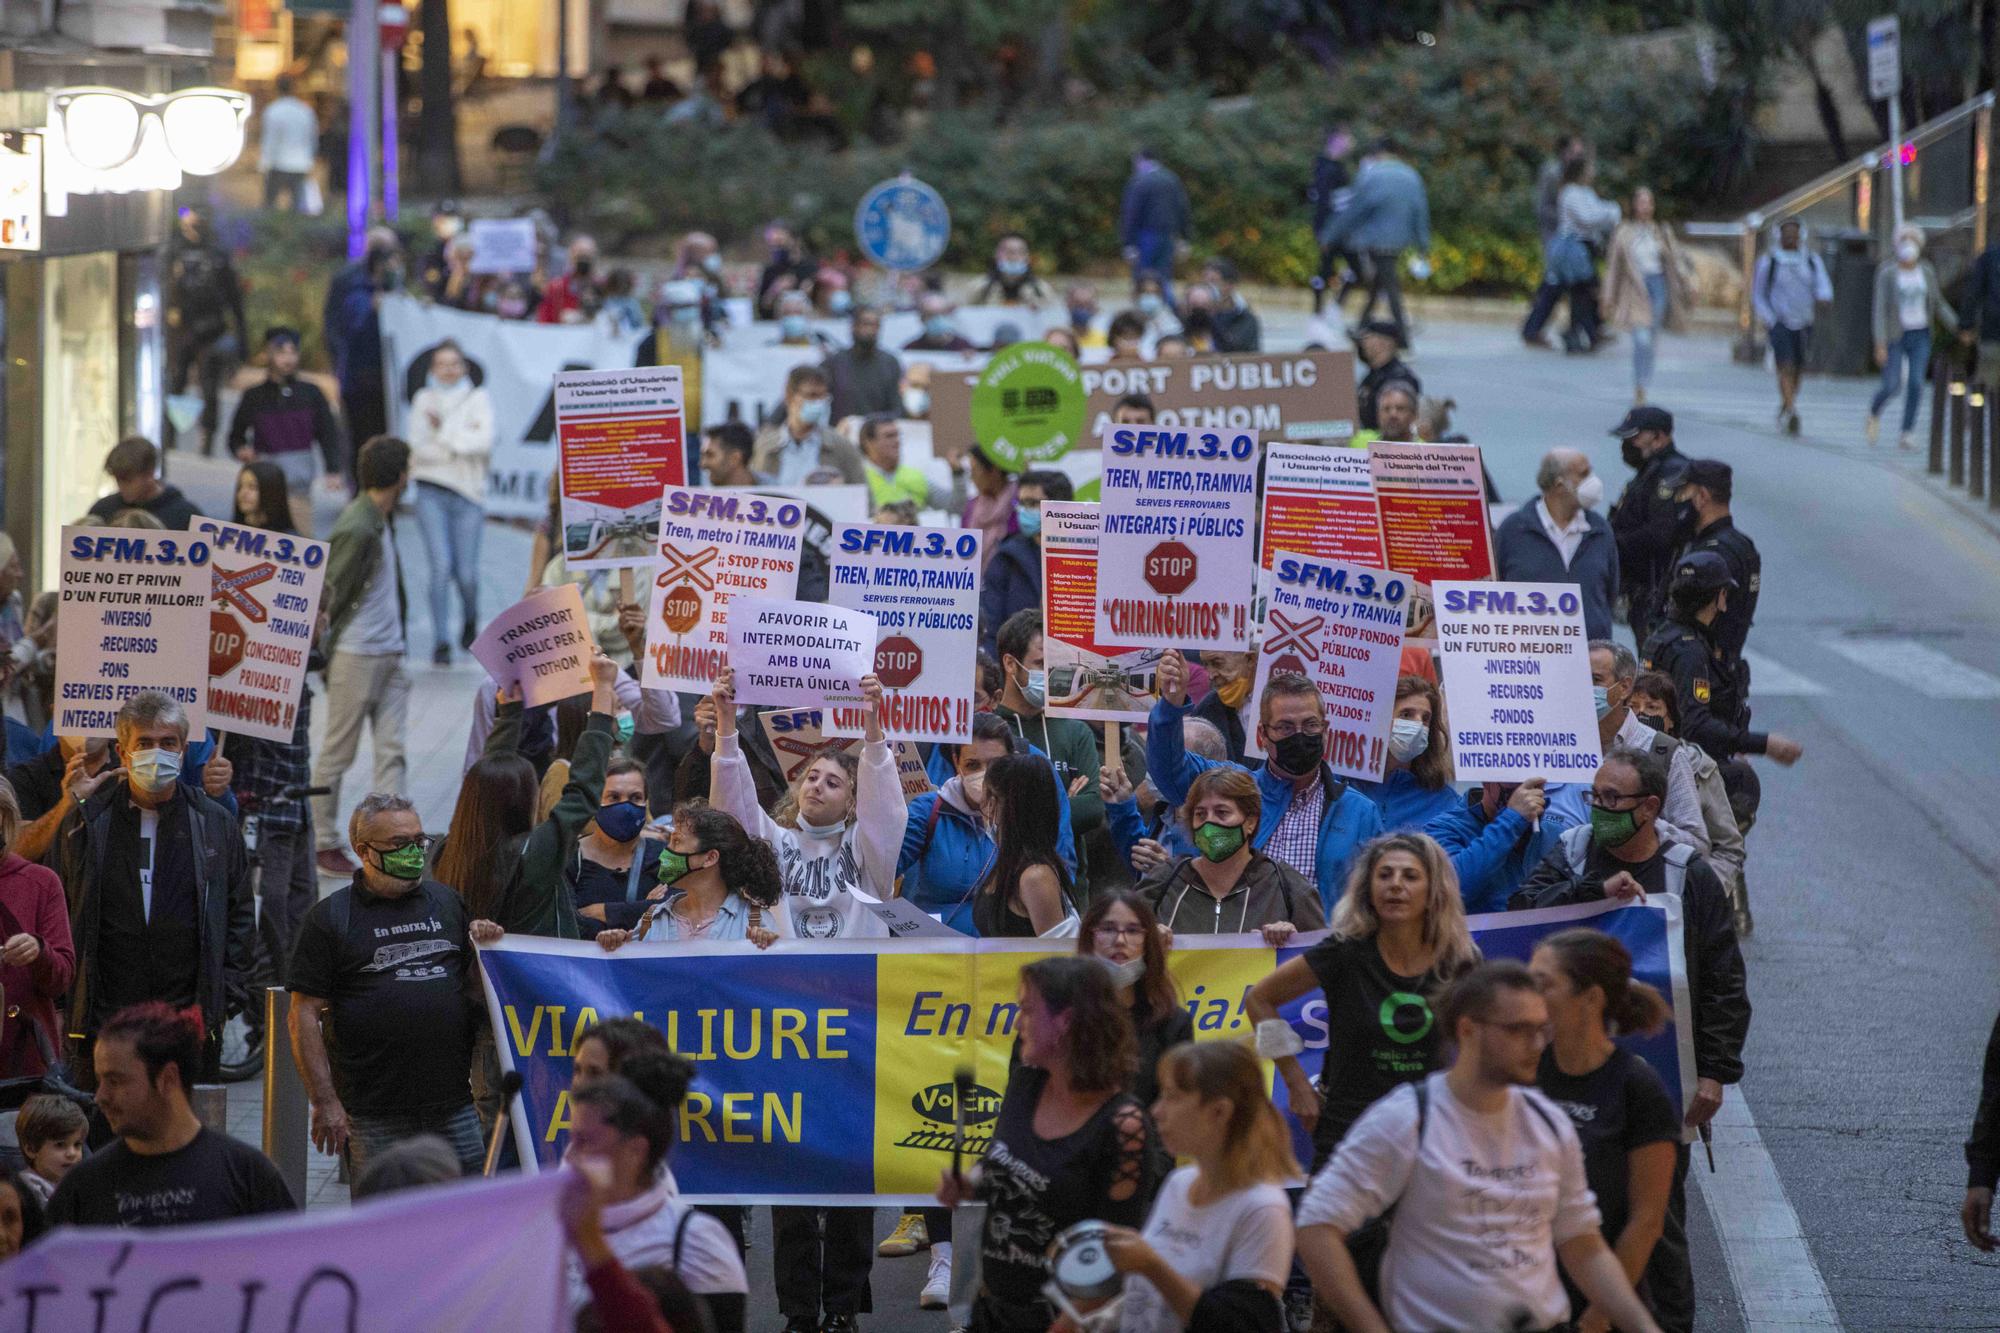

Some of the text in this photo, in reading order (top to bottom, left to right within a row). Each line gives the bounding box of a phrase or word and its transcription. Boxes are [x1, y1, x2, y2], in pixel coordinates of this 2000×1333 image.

[1190, 358, 1318, 391] PÚBLIC
[1155, 404, 1282, 432] OTHOM
[1111, 430, 1253, 460] SFM.3.0
[1107, 468, 1142, 492] TREN,
[1353, 467, 1371, 475] Tre
[667, 491, 801, 527] SFM.3.0
[1136, 498, 1231, 510] SERVEIS FERROVIARIS
[1046, 510, 1099, 520] Associaci
[1064, 522, 1099, 530] Usuari
[1104, 513, 1244, 538] INTEGRATS i PÚBLICS
[666, 521, 796, 551] Tren, metro i TRAMVIA
[839, 529, 977, 558] SFM.3.0
[70, 535, 210, 565] SFM.3.0
[728, 554, 760, 569] STOP
[762, 559, 794, 573] FONS
[1150, 557, 1192, 577] STOP
[64, 571, 181, 588] QUE NO ET PRIVIN
[716, 570, 768, 590] PÚBLICS
[835, 565, 870, 589] TREN,
[1277, 560, 1404, 602] SFM.3.0
[63, 590, 204, 608] D'UN FUTUR MILLOR!!
[666, 600, 698, 617] STOP
[863, 594, 955, 607] SERVEIS FERROVIARIS
[1274, 588, 1402, 626] Tren, metro y TRANVÍA
[1443, 590, 1579, 615] SFM.3.0
[498, 608, 574, 645] TRANSPORT
[758, 612, 829, 629] AFAVORIR
[833, 618, 848, 631] LA
[909, 612, 916, 627] Y
[918, 609, 973, 630] PÚBLICOS
[554, 632, 576, 649] PER
[577, 629, 585, 642] A
[1332, 624, 1357, 638] STOP
[1359, 628, 1400, 648] FONDOS
[1442, 623, 1581, 637] QUE NO TE PRIVEN DE
[100, 636, 157, 654] -RECURSOS
[743, 631, 862, 652] INTERMODALITAT
[1322, 639, 1371, 661] PÚBLICOS
[1445, 641, 1573, 655] UN FUTURO MEJOR!!
[245, 640, 303, 667] CONCESIONES
[768, 655, 831, 670] AMB UNA
[876, 652, 918, 671] STOP
[99, 662, 129, 679] -FONS
[531, 655, 580, 678] TOTHOM
[1318, 661, 1345, 677] PARA
[1484, 656, 1541, 675] -INVERSIÓN
[239, 669, 282, 692] PRIVADAS
[748, 674, 850, 691] TARJETA ÚNICA
[62, 683, 113, 700] SERVEIS
[1317, 681, 1375, 703] BENEFICIOS
[1487, 684, 1544, 700] -RECURSOS
[62, 709, 118, 729] INTEGRAT
[1490, 709, 1535, 725] -FONDOS
[1458, 732, 1577, 747] SERVEIS FERROVIARIS
[1460, 749, 1598, 769] INTEGRADOS Y PÚBLICOS
[374, 917, 442, 938] En marxa, ja
[904, 990, 971, 1037] En
[678, 1092, 803, 1145] REN
